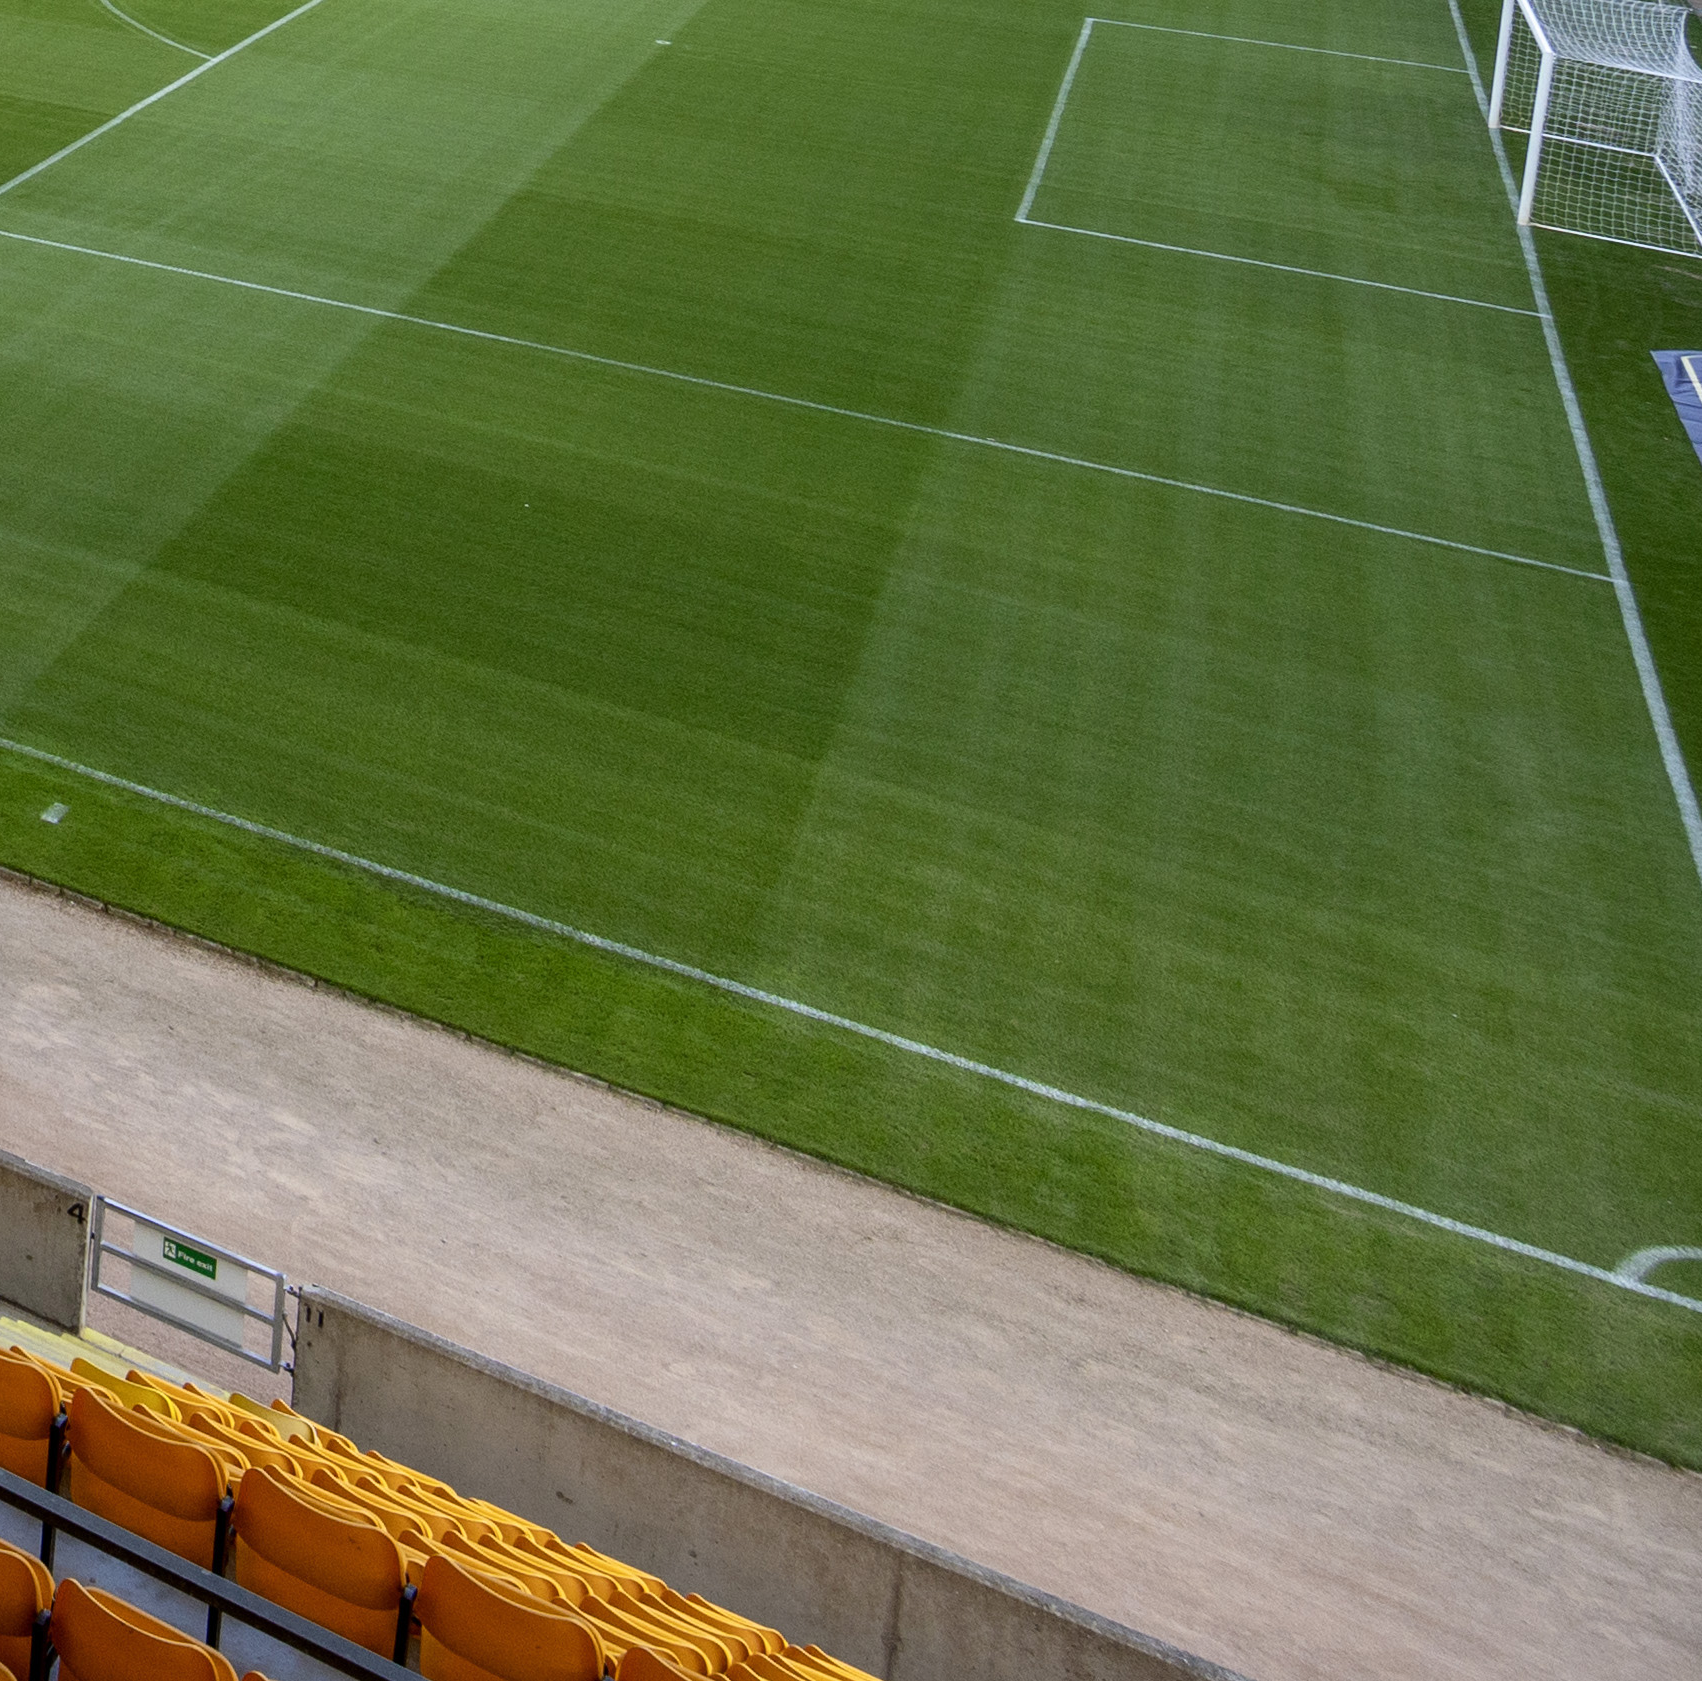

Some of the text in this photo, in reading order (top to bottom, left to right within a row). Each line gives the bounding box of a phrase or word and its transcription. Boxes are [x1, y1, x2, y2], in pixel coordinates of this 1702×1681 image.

[66, 1202, 86, 1224] 4
[177, 1249, 215, 1273] Fire exit
